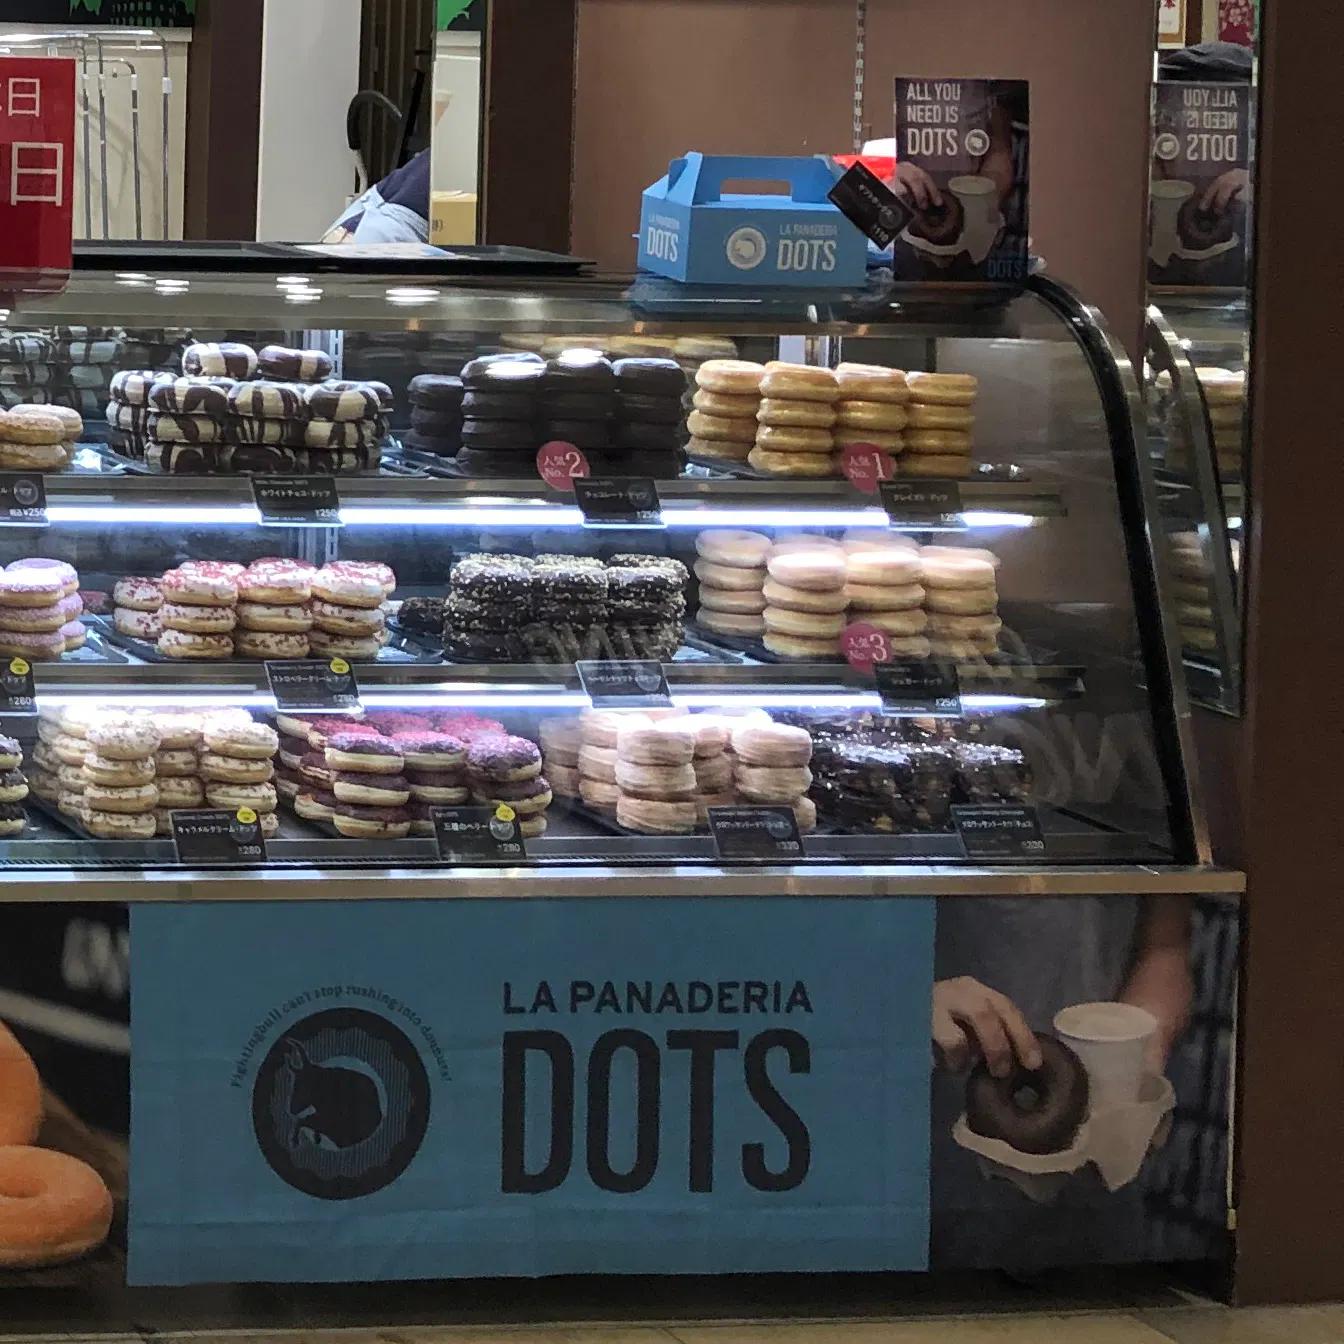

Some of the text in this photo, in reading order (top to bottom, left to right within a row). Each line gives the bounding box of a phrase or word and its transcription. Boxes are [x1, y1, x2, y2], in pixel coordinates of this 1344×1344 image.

[907, 82, 962, 102] ALL YOU
[906, 104, 959, 124] NEED IS
[906, 127, 959, 157] DOTS
[646, 226, 679, 263] DOTS
[777, 239, 837, 272] DOTS
[502, 979, 814, 1015] LA PANADERIA
[500, 1027, 812, 1196] DOTS
